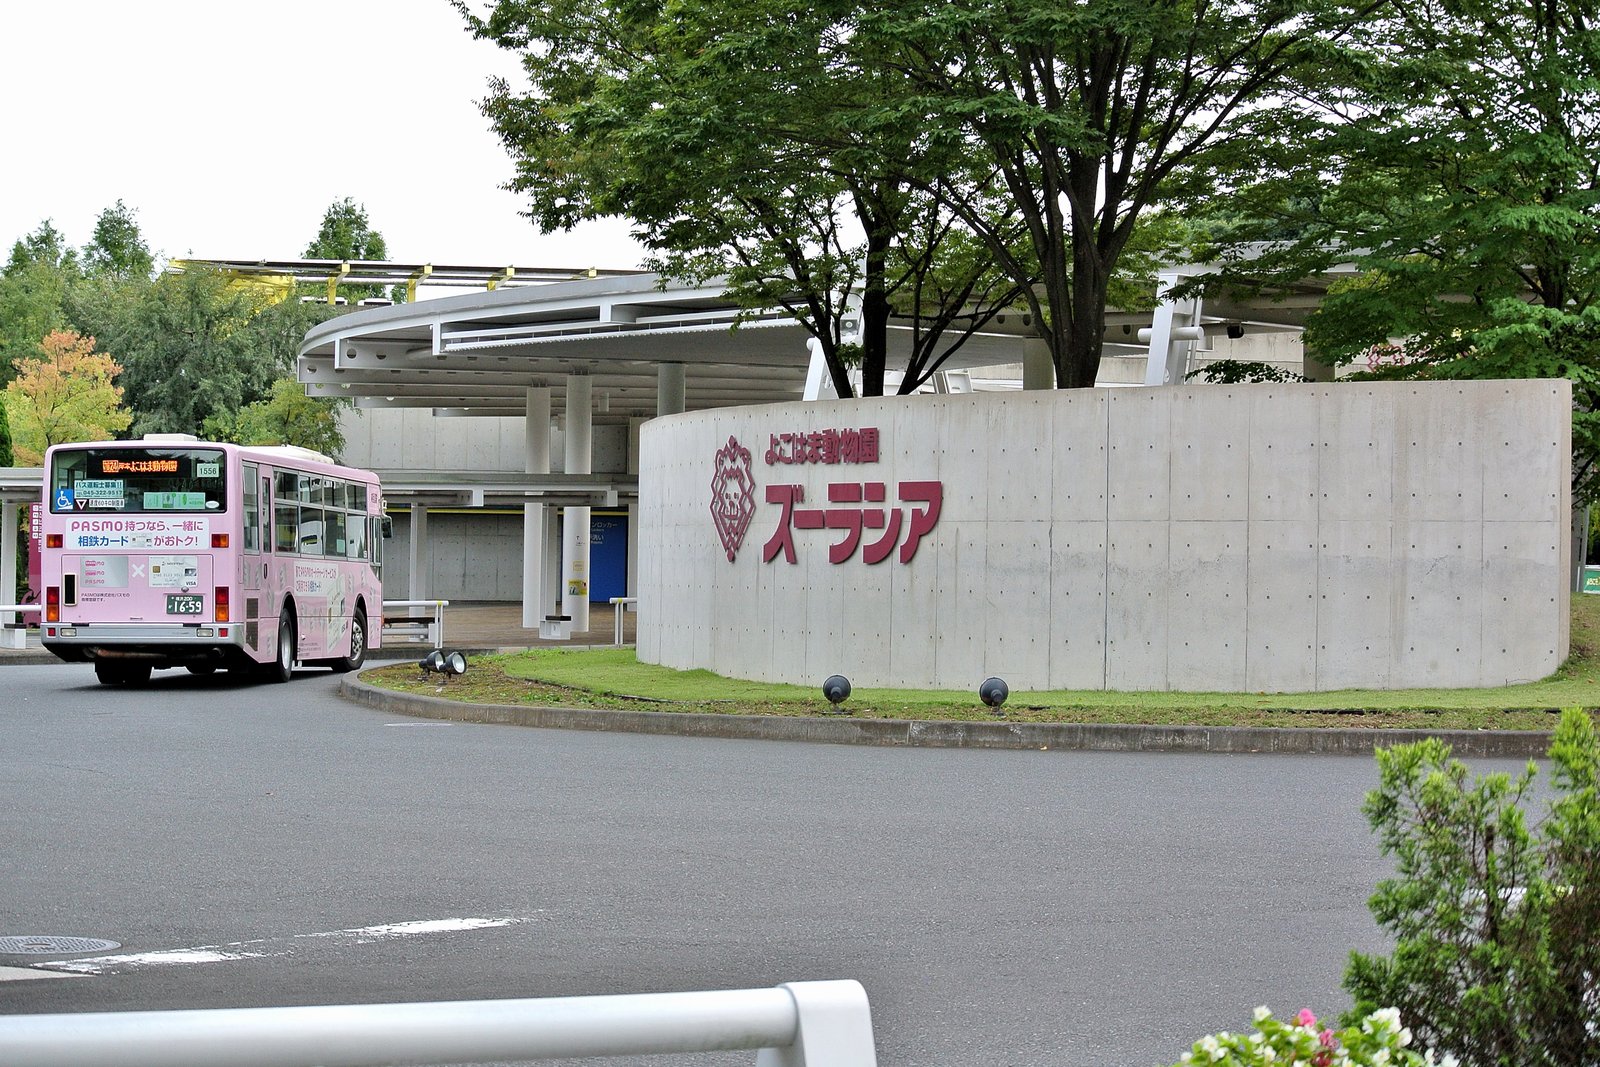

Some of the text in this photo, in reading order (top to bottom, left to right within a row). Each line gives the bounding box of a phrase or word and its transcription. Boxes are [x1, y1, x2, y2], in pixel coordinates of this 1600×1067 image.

[765, 427, 879, 464] よこはま動物園
[200, 467, 216, 476] 1556
[72, 521, 204, 532] PASMO 持つなら、一緒に
[763, 481, 943, 564] ズーラシア
[78, 536, 198, 546] 相鉄カード がおトク!
